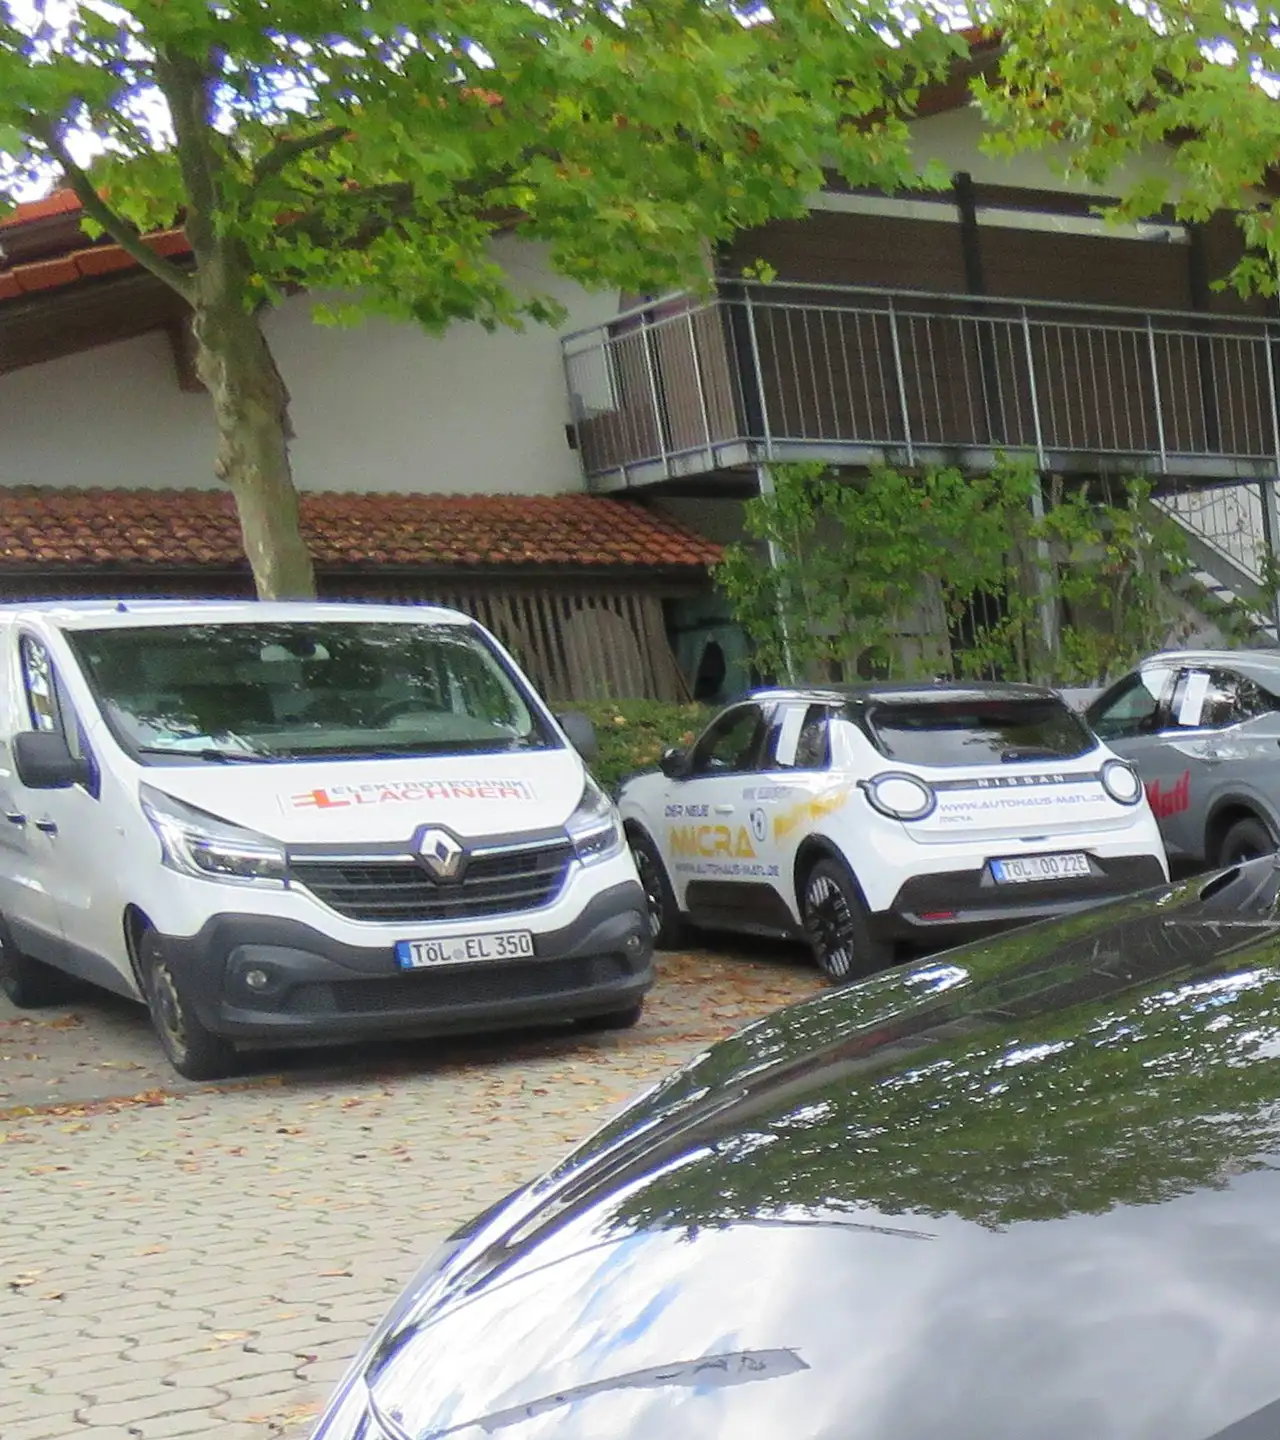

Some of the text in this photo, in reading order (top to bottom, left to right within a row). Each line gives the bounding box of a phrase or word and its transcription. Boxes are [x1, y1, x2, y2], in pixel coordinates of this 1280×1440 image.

[331, 778, 526, 795] ELEKTROTECHNIK
[977, 773, 1065, 788] NISSAN
[354, 786, 523, 805] LACHNER
[940, 793, 1107, 813] WWW.AUTOHAUS-MATL.DE
[669, 824, 757, 859] MICRA
[1002, 861, 1031, 877] TÖL
[1061, 855, 1088, 872] 22E
[412, 934, 531, 964] TÖL EL 350
